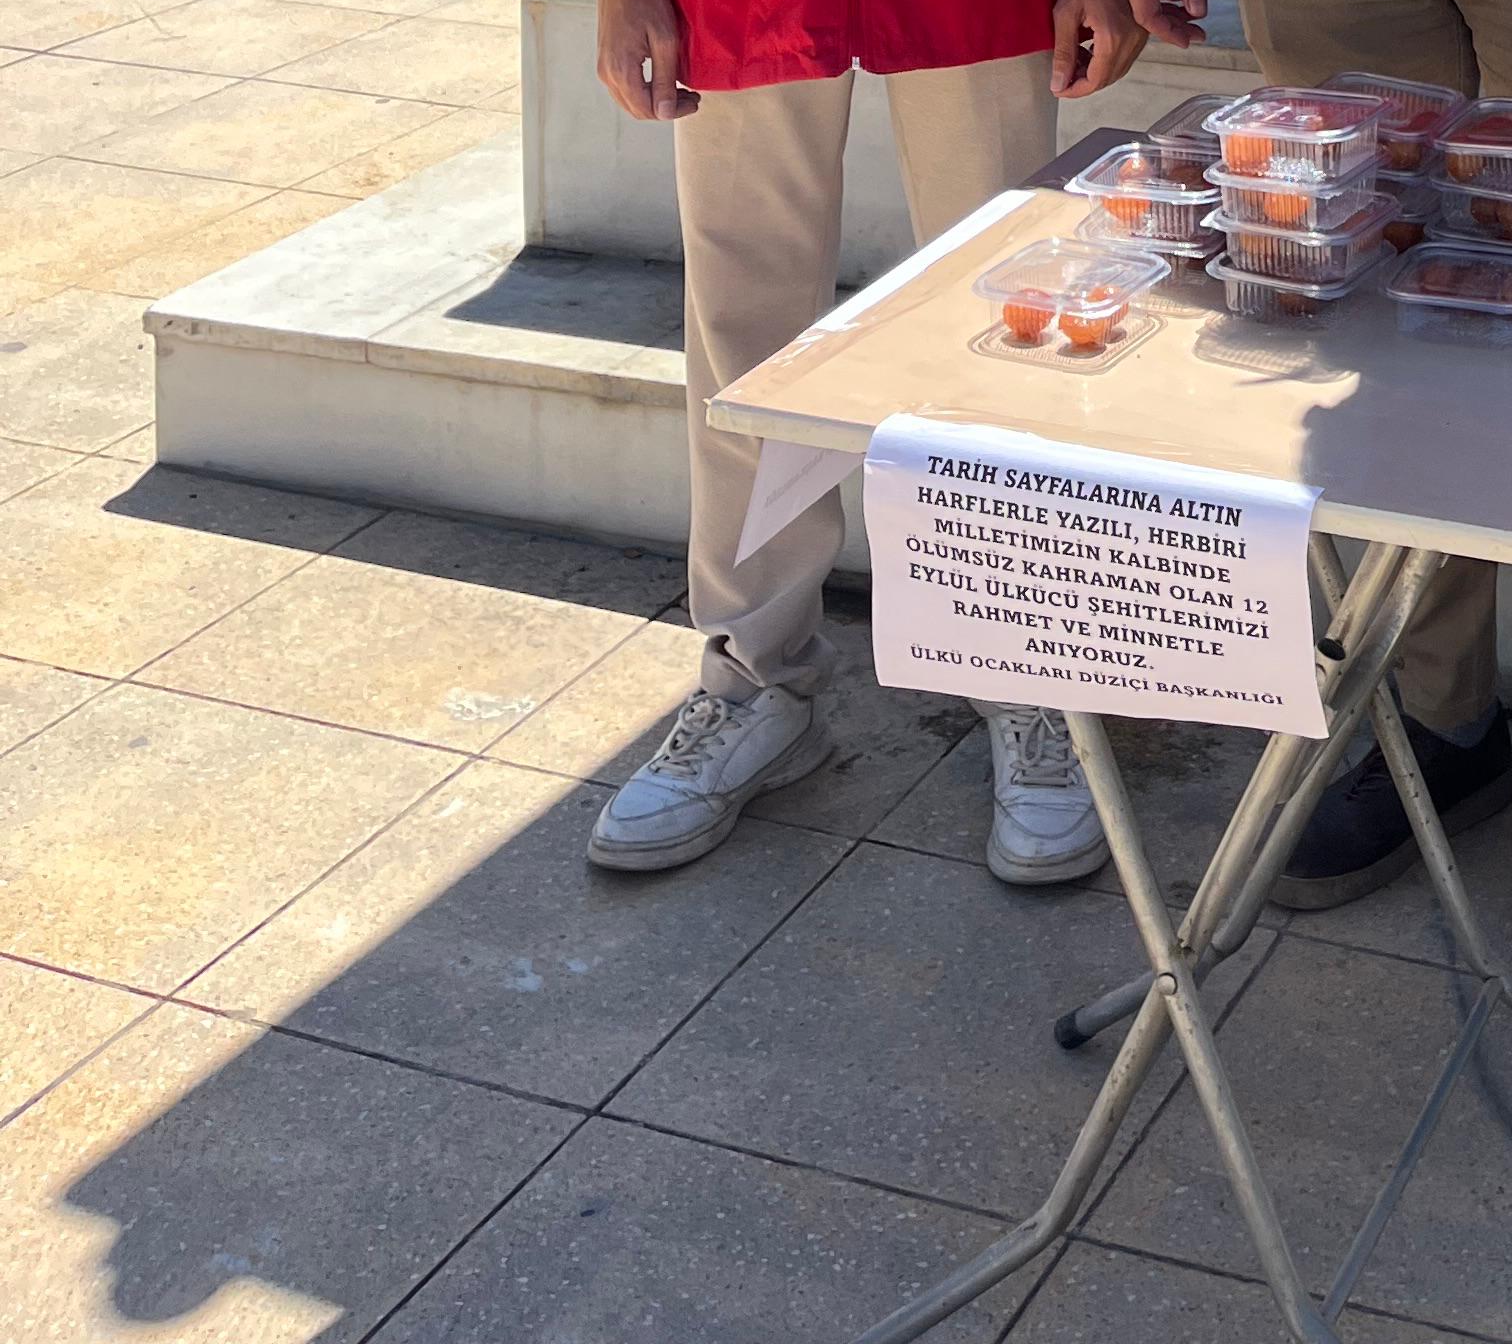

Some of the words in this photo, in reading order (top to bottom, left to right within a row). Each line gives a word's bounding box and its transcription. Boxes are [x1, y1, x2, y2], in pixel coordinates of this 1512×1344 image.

[917, 486, 1050, 526] HARFLERLE
[1055, 509, 1141, 546] YAZILI,
[1147, 526, 1248, 560] HERBİRİ
[927, 454, 999, 485] TARİH
[1003, 468, 1164, 515] SAYFALARINA
[1168, 497, 1243, 528] ALTIN
[905, 533, 1016, 574] ÖLÜMSÜZ
[1022, 559, 1161, 599] KAHRAMAN
[1168, 585, 1235, 610] OLAN
[1242, 597, 1270, 616] 12
[933, 517, 1101, 562] MİLLETİMİZİN
[1108, 547, 1232, 585] KALBİNDE
[908, 562, 979, 593] EYLÜL
[985, 575, 1080, 611] ÜLKÜCÜ
[1087, 596, 1271, 640] ŞEHİTLERİMİZİ
[952, 599, 1054, 632] RAHMET
[1063, 619, 1092, 638] VE
[1098, 622, 1226, 658] MİNNETLE
[910, 643, 963, 665] ÜLKÜ
[970, 654, 1073, 681] OCAKLARI
[1079, 668, 1150, 693] DÜZİÇİ
[1156, 679, 1285, 706] BAŞKANLIĞI
[1025, 637, 1155, 671] ANIYORUZ.
